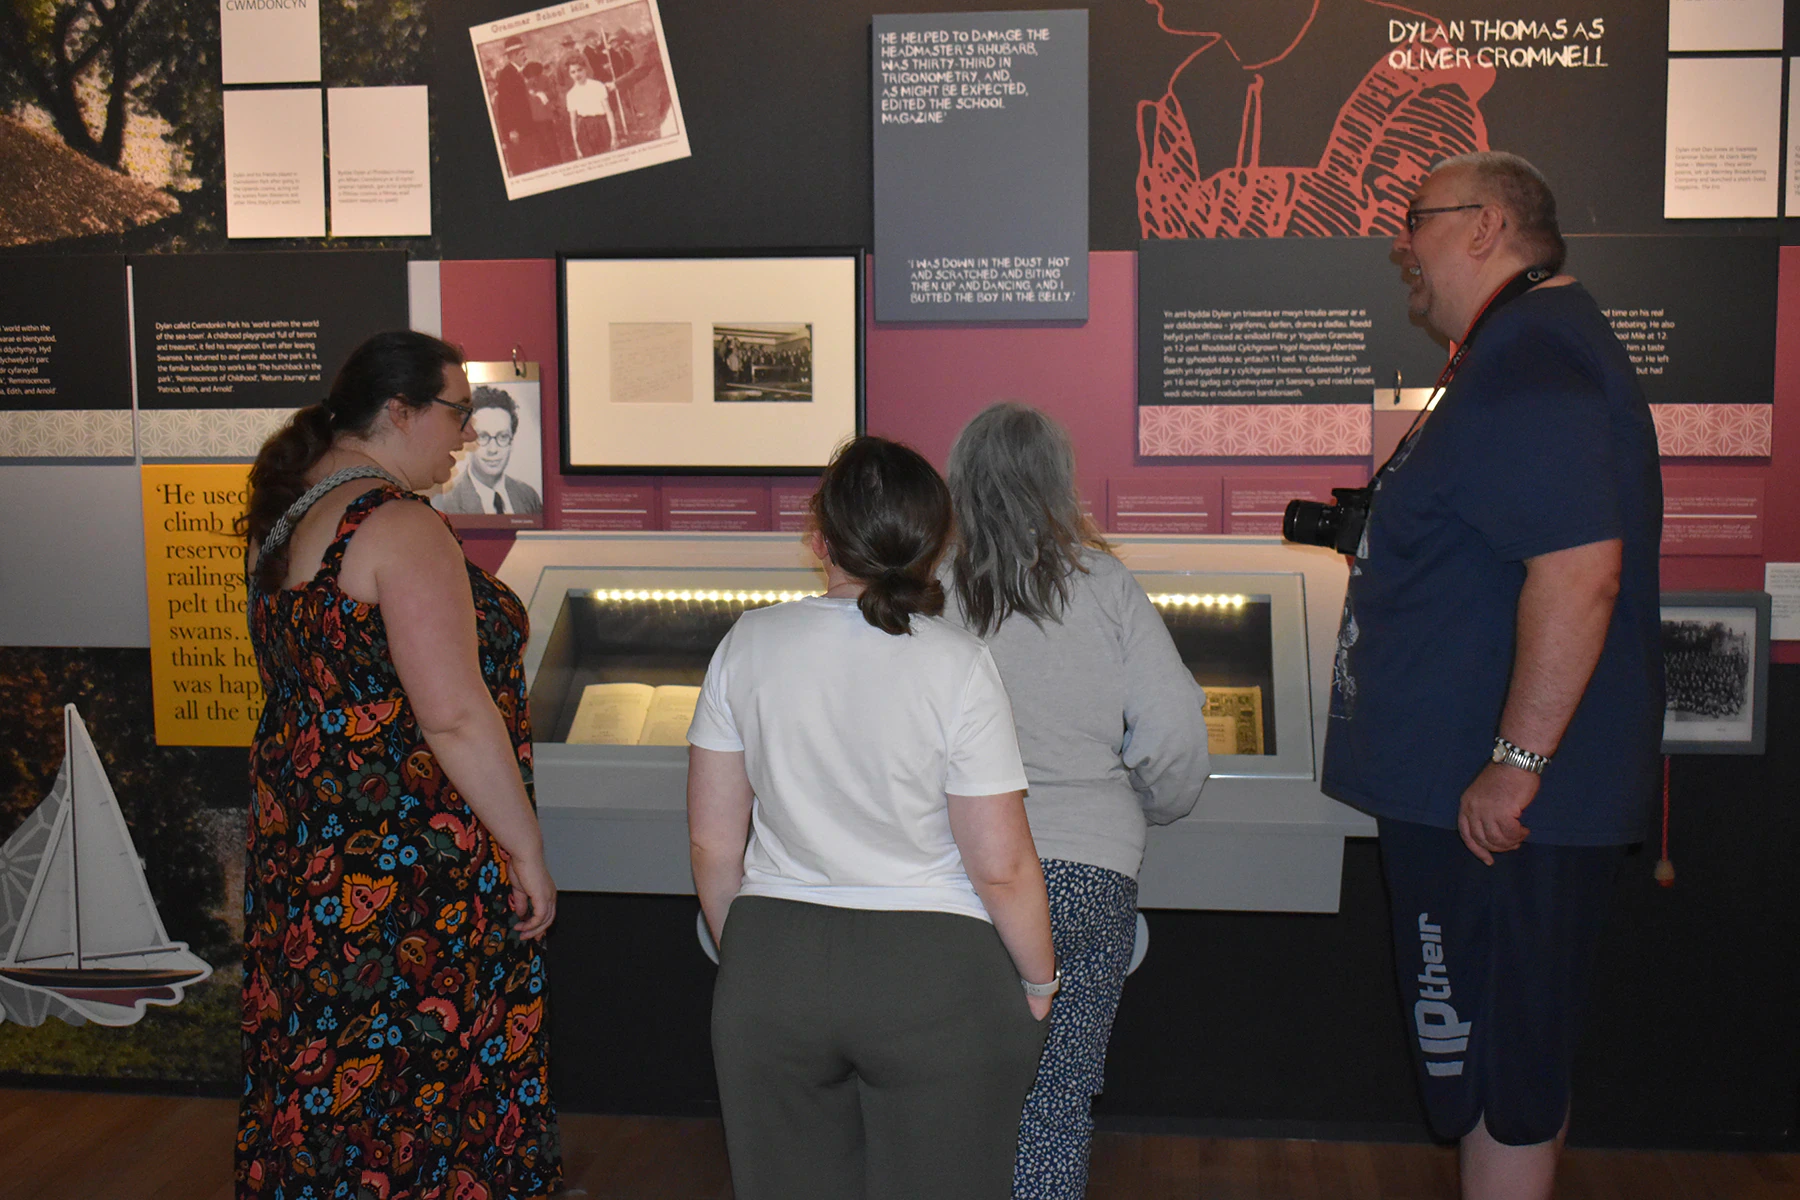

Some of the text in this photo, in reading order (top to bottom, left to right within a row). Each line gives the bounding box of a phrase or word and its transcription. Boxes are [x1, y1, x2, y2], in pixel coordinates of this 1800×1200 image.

[226, 0, 306, 10] CWMDONCYN
[536, 9, 565, 22] School
[901, 31, 949, 44] HELPED
[952, 31, 968, 42] TO
[972, 29, 1022, 42] DAMAGE
[1027, 28, 1050, 41] THE
[1389, 17, 1605, 43] DYLAN THOMAS AS
[881, 43, 1038, 57] HEADMASTER'S RHUBARB,
[881, 59, 909, 71] WAS
[999, 57, 1011, 68] IN
[1388, 45, 1608, 70] OLIVER CROMWELL
[882, 82, 1029, 97] AS MIGHT BE EXPECTED,
[881, 97, 1005, 111] EDITED THE SCHOOL
[917, 259, 940, 269] WAS
[942, 257, 975, 268] DOWN
[978, 258, 988, 268] IN
[992, 257, 1011, 267] THE
[1048, 257, 1070, 267] HOT
[911, 269, 1060, 280] AND SCRATCHED AND BITING
[911, 281, 938, 292] THEN
[941, 281, 956, 291] UP
[959, 281, 980, 291] AND
[1035, 280, 1057, 290] AND
[1060, 280, 1064, 289] I
[910, 293, 951, 303] BUTTED
[954, 292, 973, 303] THE
[977, 292, 998, 303] BOY
[1002, 292, 1012, 302] IN
[1016, 292, 1035, 302] THE
[155, 322, 173, 331] Dylan
[191, 321, 226, 329] Cwmdonkin
[227, 321, 239, 329] Park
[241, 321, 250, 329] his
[291, 320, 301, 328] the
[302, 320, 319, 328] world
[207, 332, 212, 340] A
[243, 332, 275, 341] playground
[288, 331, 295, 339] of
[296, 331, 317, 339] terrors
[294, 342, 315, 351] leaving
[241, 353, 258, 361] wrote
[191, 364, 218, 373] backdrop
[164, 511, 223, 532] climb
[168, 566, 244, 592] railings
[168, 593, 248, 619] pelt the
[172, 647, 227, 667] think
[173, 679, 211, 694] was
[175, 701, 198, 720] all
[207, 701, 239, 720] the
